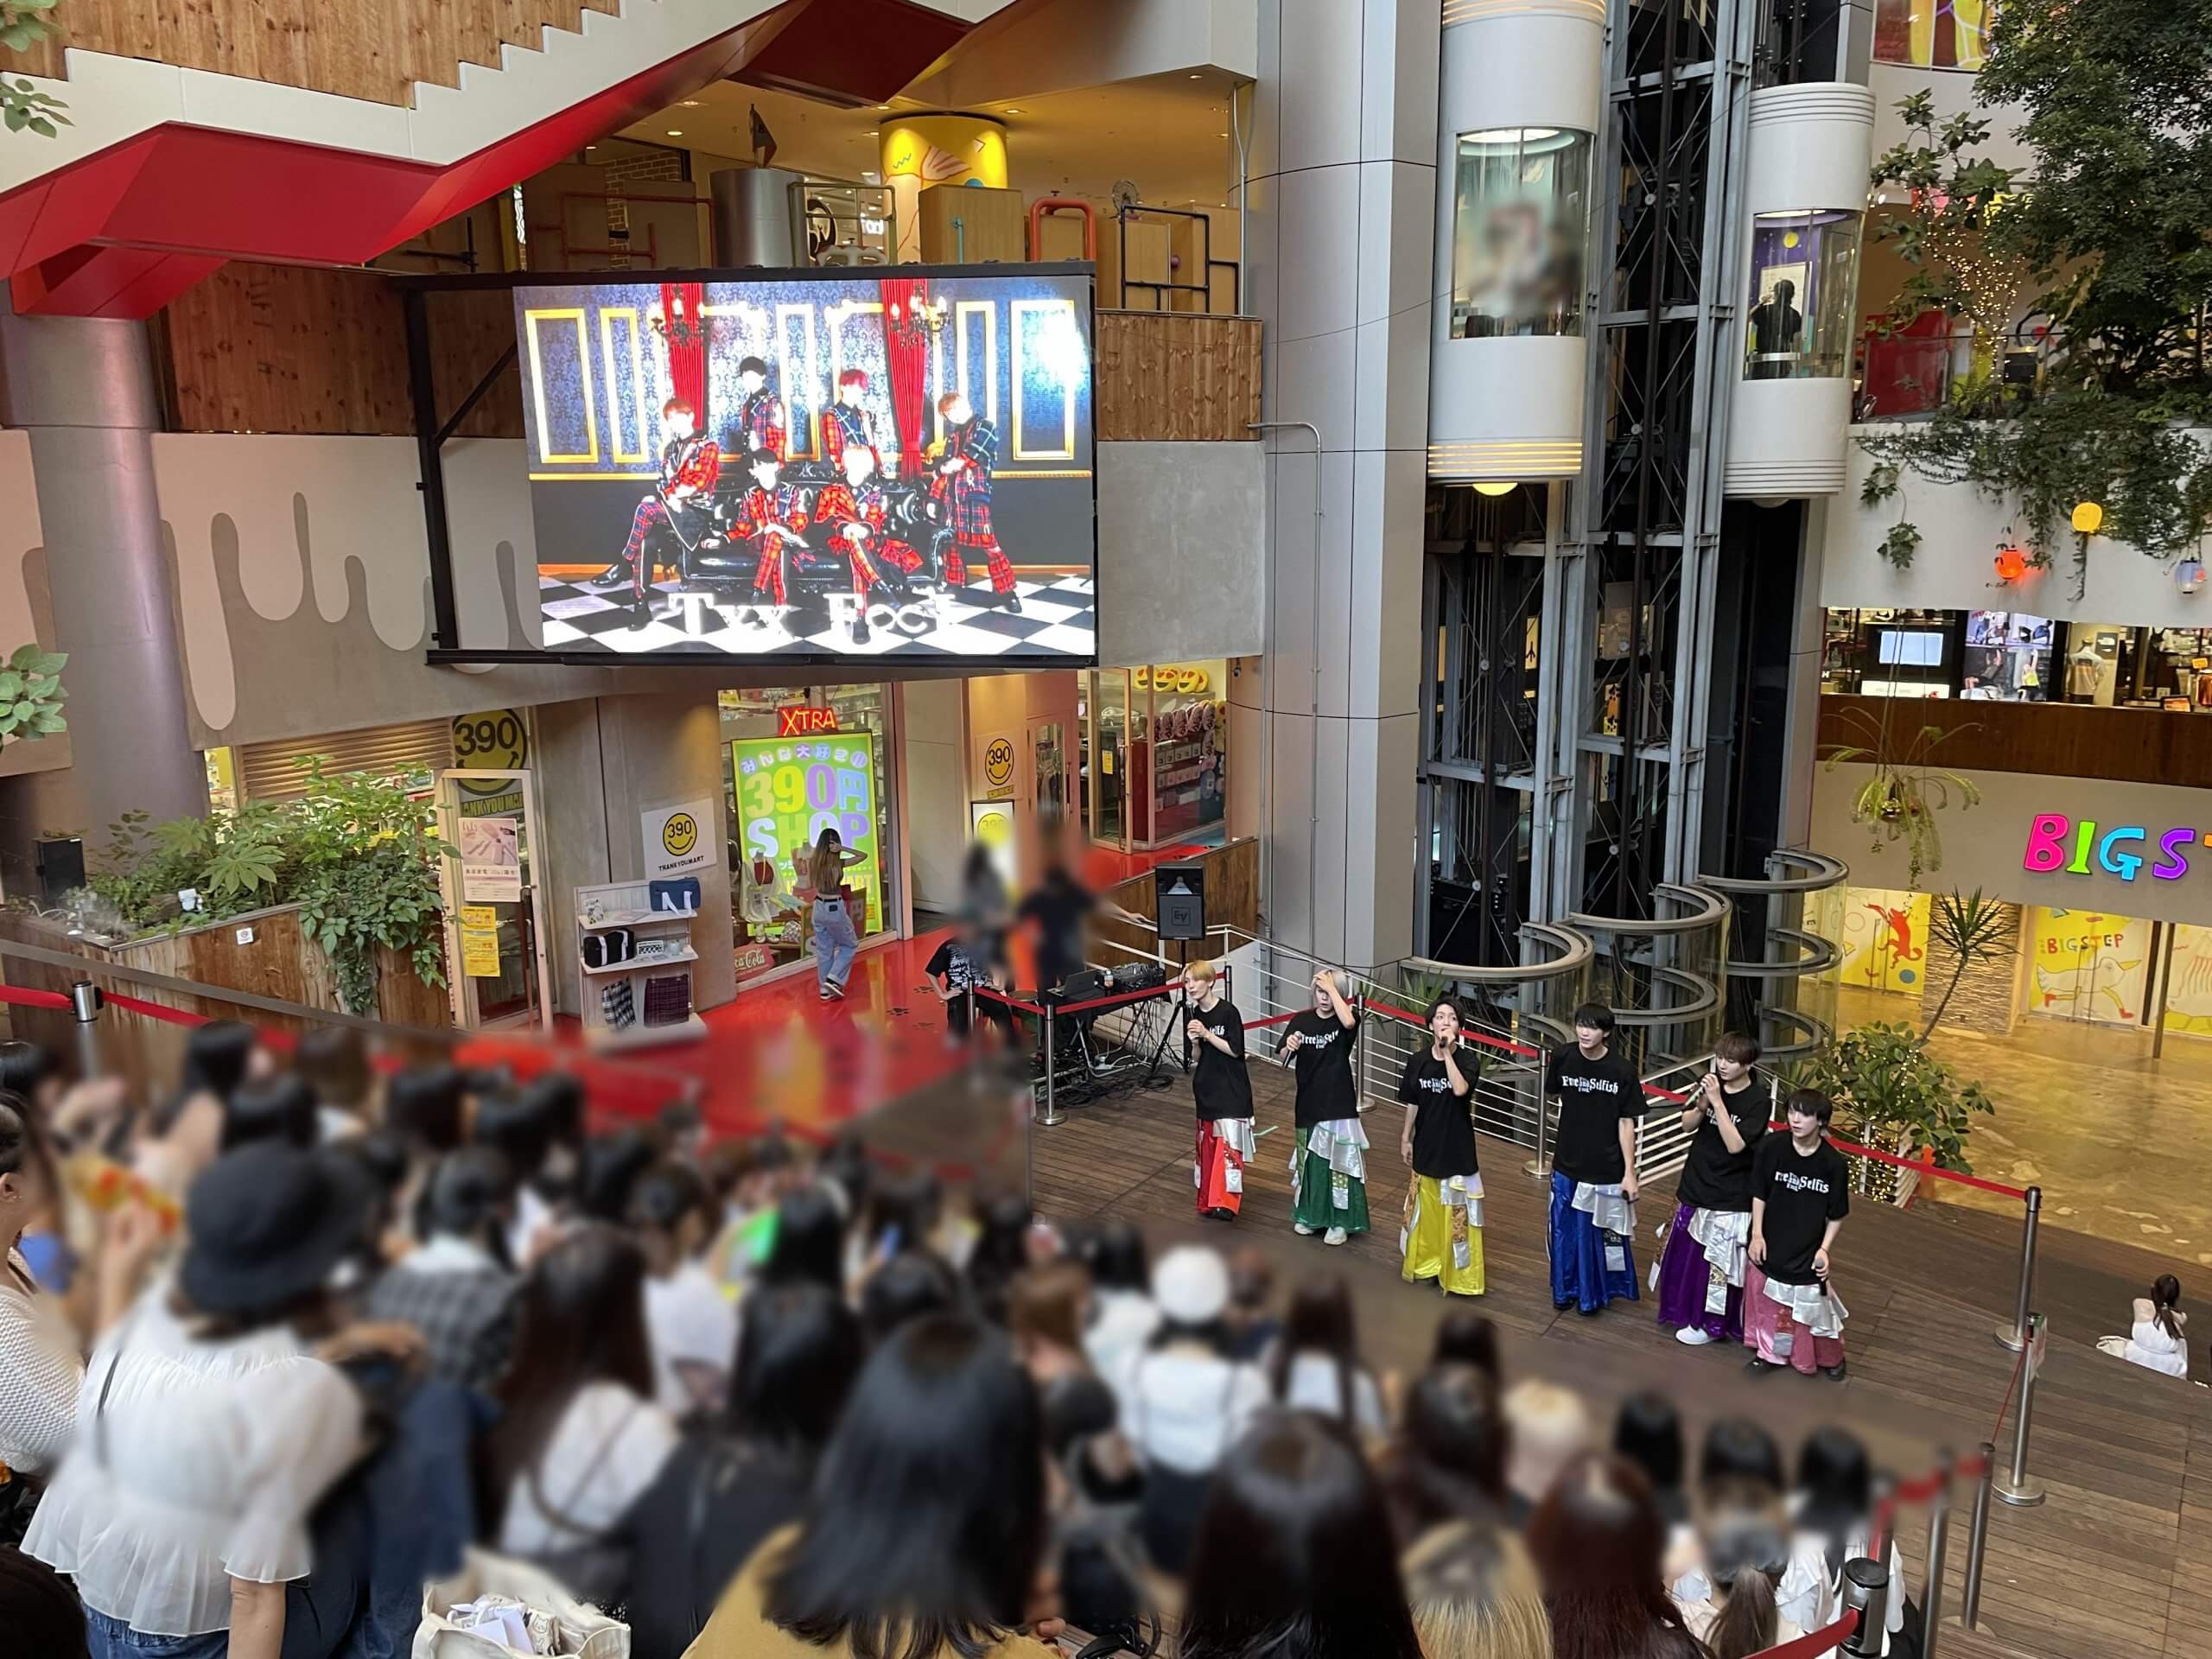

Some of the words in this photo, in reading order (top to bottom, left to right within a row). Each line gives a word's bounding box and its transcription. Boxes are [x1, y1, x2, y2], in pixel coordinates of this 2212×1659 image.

[454, 717, 518, 756] 390
[781, 709, 836, 737] XTRA
[988, 746, 1011, 766] 390
[744, 763, 869, 817] 390円
[667, 820, 692, 838] 390
[747, 811, 870, 858] SHOP
[2024, 813, 2212, 881] BIGS
[2047, 933, 2124, 954] BIGSTEP
